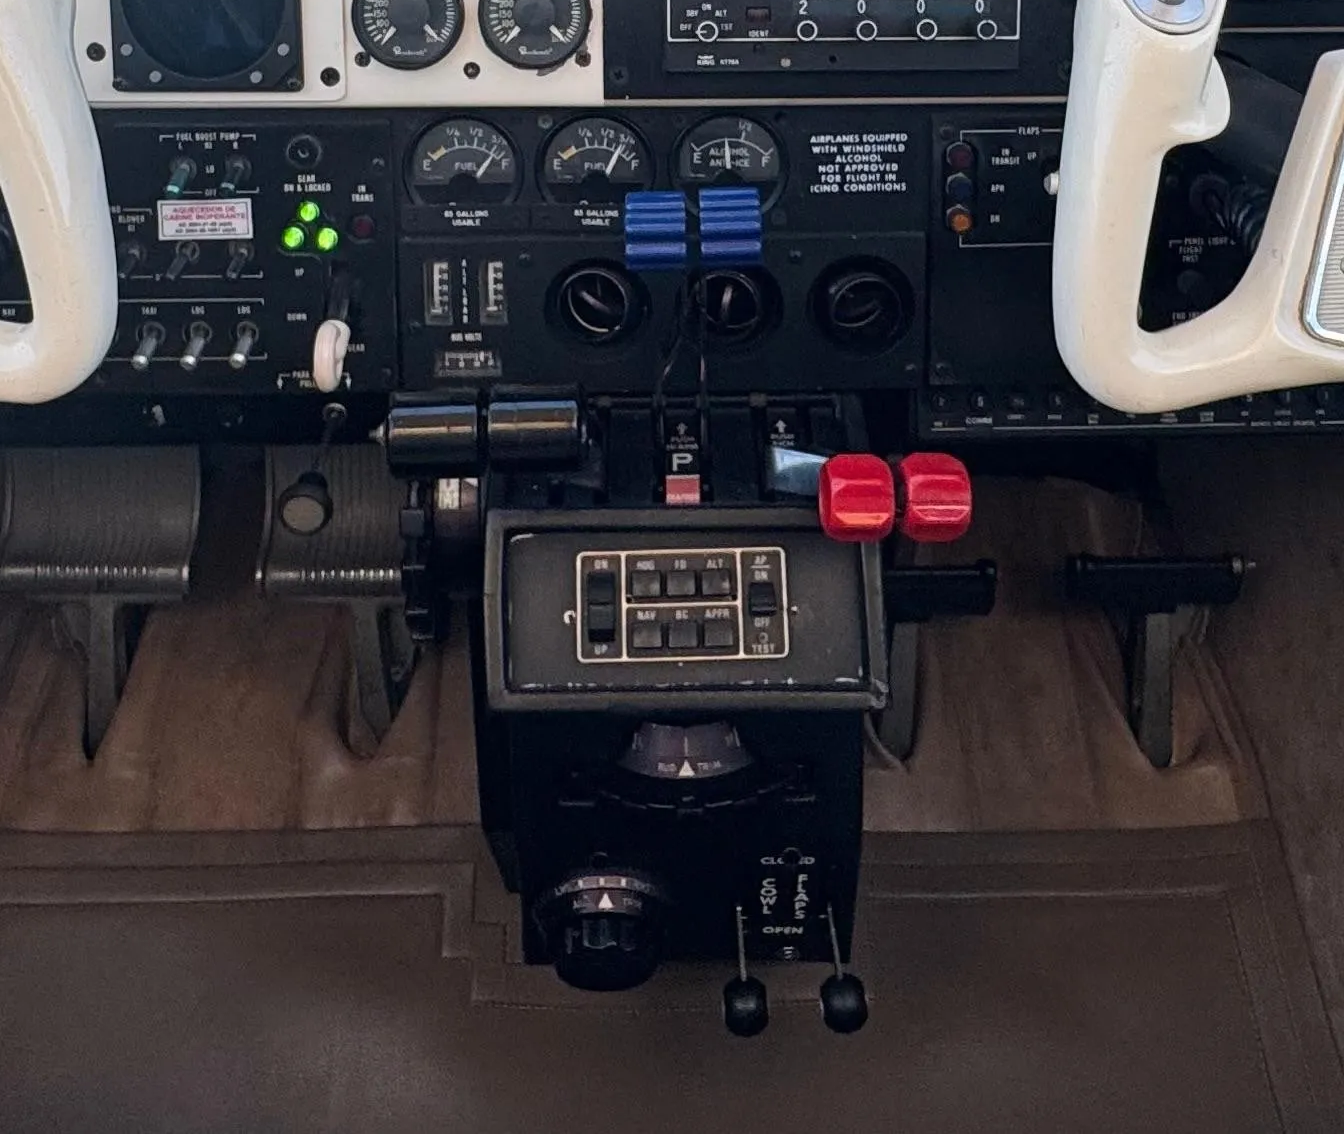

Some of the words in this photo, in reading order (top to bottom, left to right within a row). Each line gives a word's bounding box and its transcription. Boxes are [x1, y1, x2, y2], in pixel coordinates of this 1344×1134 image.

[799, 0, 808, 15] 2
[1018, 127, 1040, 135] FLAPS
[176, 133, 193, 141] FUEL
[195, 133, 217, 141] BOOST
[219, 132, 240, 141] PUMP
[810, 134, 860, 144] AIRPLANES
[863, 133, 908, 142] EQUIPPED
[812, 145, 838, 154] WITH
[842, 144, 905, 153] WINDSHIELD
[693, 152, 702, 164] E
[761, 156, 770, 167] F
[835, 154, 882, 163] ALCOHOL
[991, 156, 1020, 165] TRANSIT
[423, 160, 431, 171] E
[501, 159, 509, 170] F
[553, 159, 561, 170] E
[631, 159, 639, 170] F
[819, 164, 839, 173] NOT
[845, 163, 899, 172] APPROVED
[297, 174, 316, 182] GEAR
[821, 174, 841, 183] FOR
[846, 173, 881, 182] FLIGHT
[885, 173, 897, 181] IN
[304, 183, 331, 192] LOCKED
[810, 184, 839, 193] ICING
[844, 182, 907, 192] CONDITIONS
[672, 453, 693, 472] P
[706, 559, 724, 569] ALT
[637, 610, 656, 620] NAV
[754, 618, 770, 627] OFF
[594, 645, 608, 655] UP
[752, 645, 775, 653] TEST
[760, 878, 778, 914] COWL
[794, 874, 809, 919] FLAPS
[762, 926, 804, 935] OPEN
